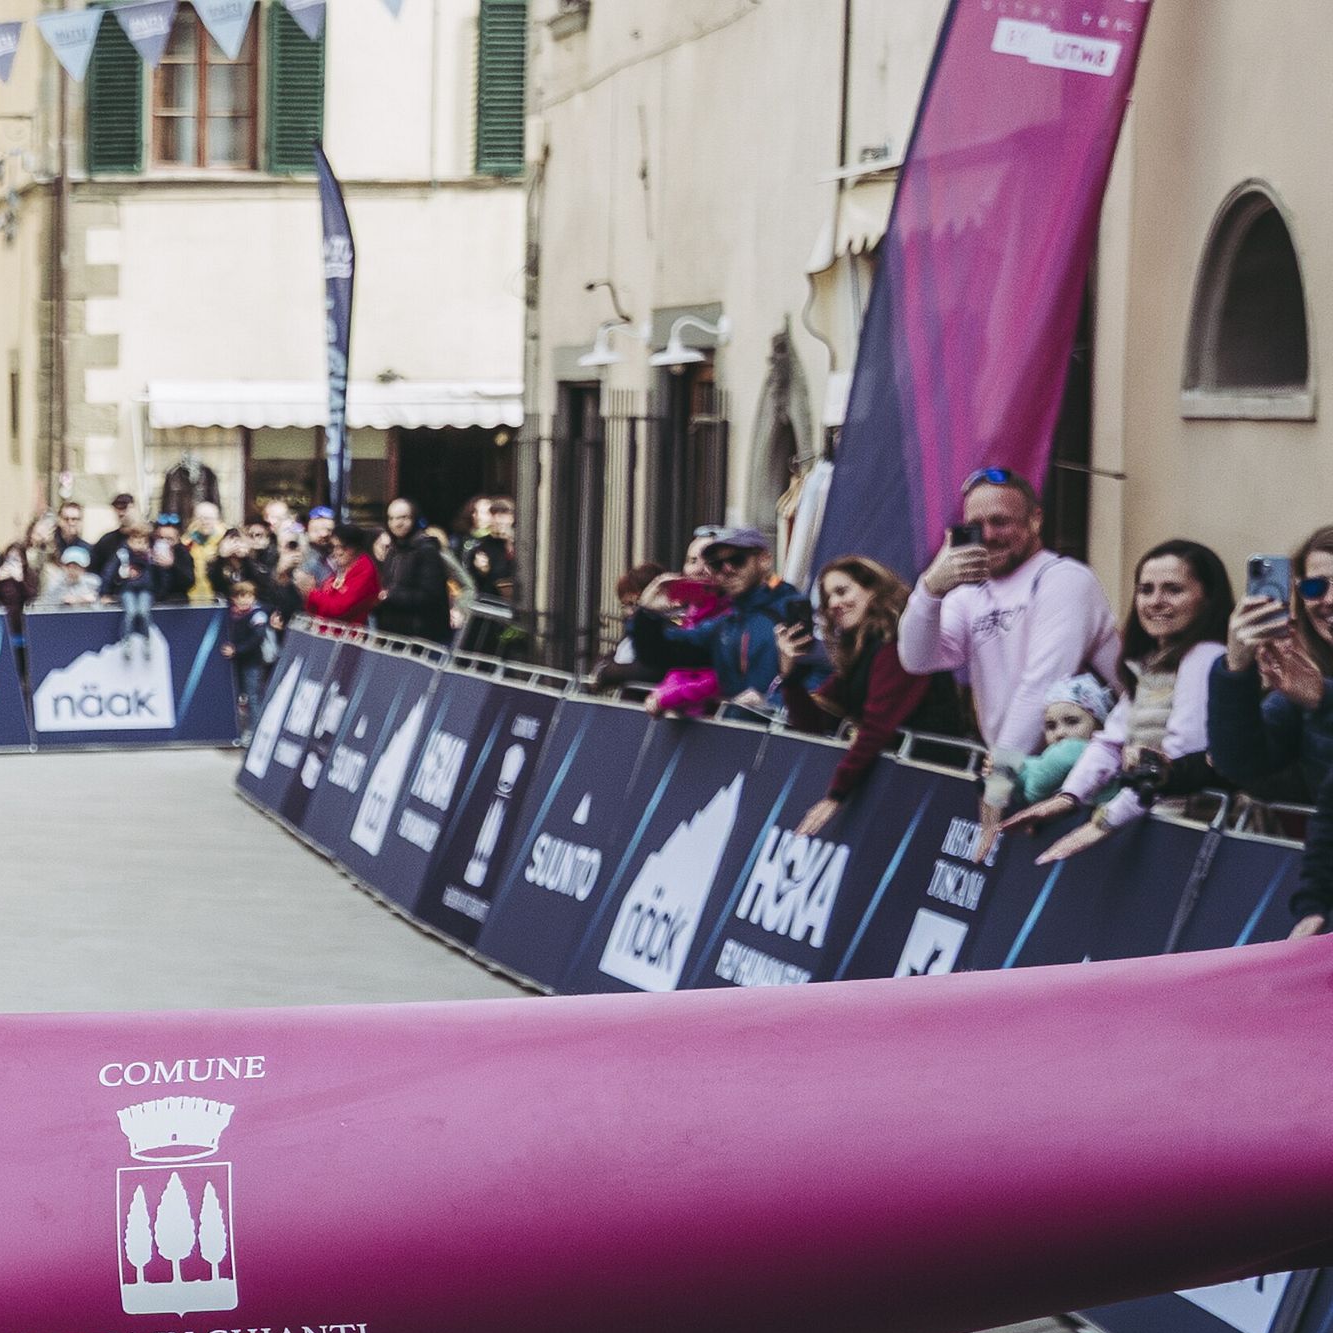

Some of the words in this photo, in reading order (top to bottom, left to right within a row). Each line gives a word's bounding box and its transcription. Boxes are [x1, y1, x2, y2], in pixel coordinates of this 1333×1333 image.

[524, 831, 603, 902] SUUNTO
[735, 824, 851, 949] HOKA
[97, 1055, 267, 1088] COMUNE
